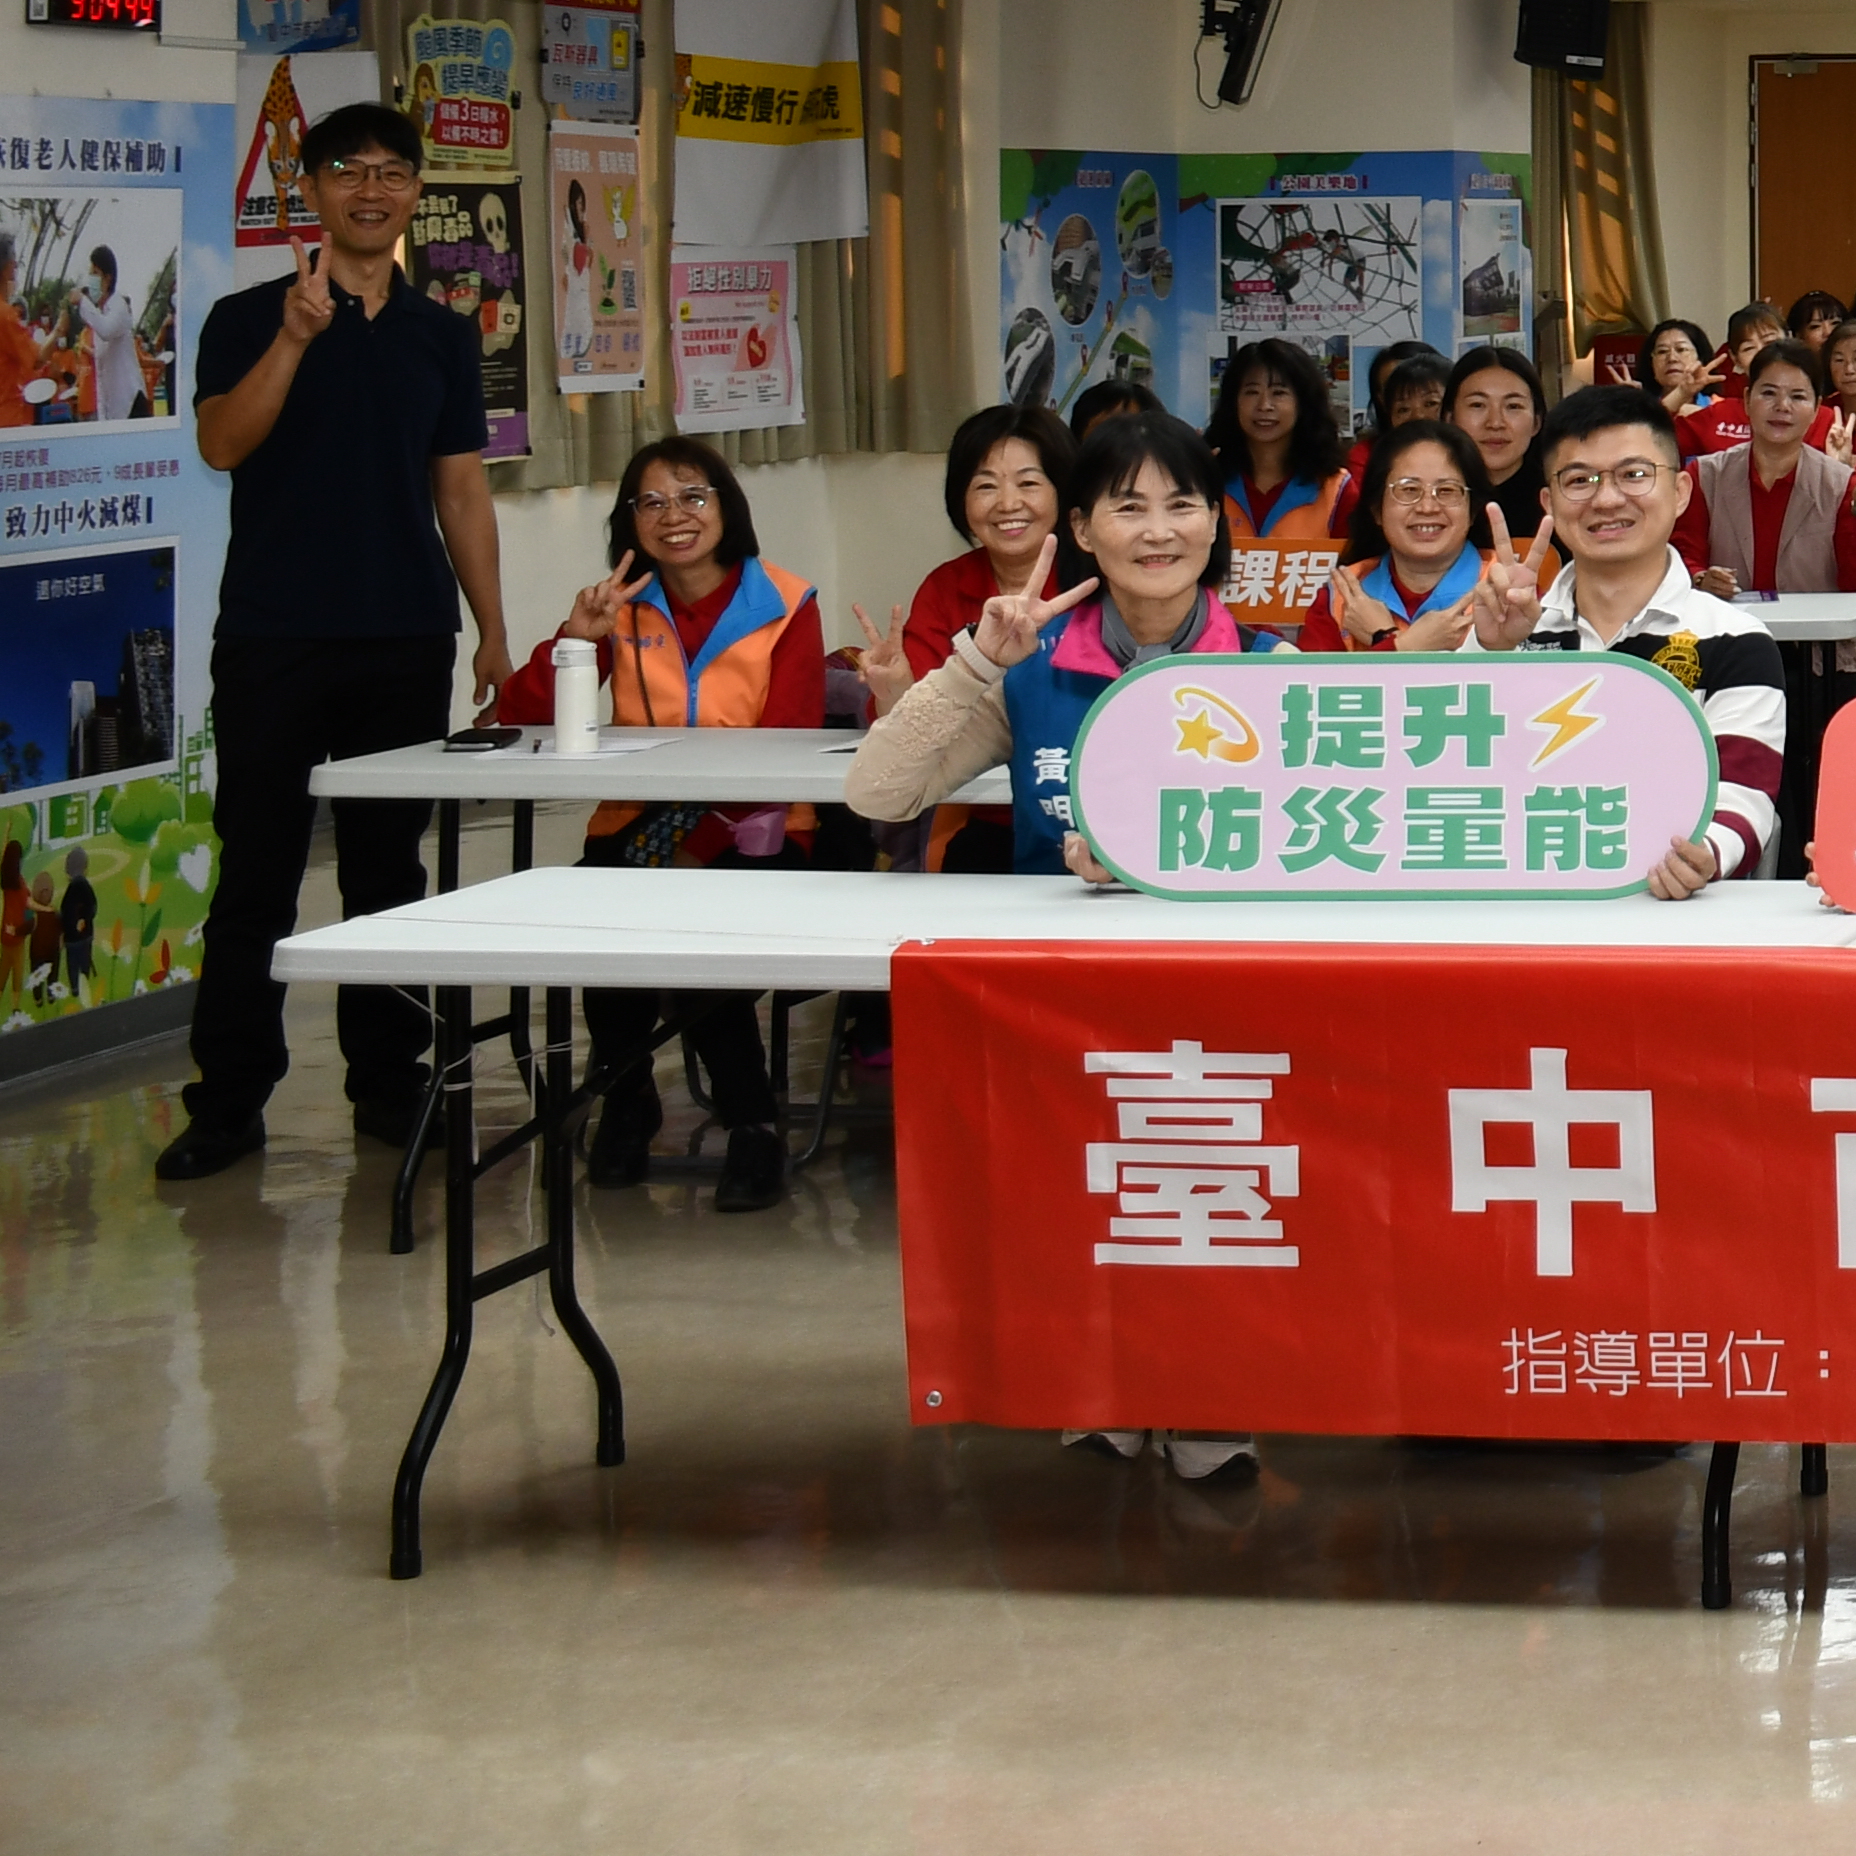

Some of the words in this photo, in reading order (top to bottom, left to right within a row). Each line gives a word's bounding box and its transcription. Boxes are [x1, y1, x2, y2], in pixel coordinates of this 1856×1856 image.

[414, 26, 483, 62] 颱風季節
[0, 136, 167, 174] 復老人健保補助
[688, 265, 773, 293] 拒絕性別暴力
[0, 448, 49, 469] 月起恢復
[6, 494, 141, 538] 致力中火減煤
[1219, 549, 1339, 608] 課程
[1280, 683, 1506, 769] 提升
[1033, 747, 1077, 837] 黃明
[1157, 785, 1629, 875] 防災量能
